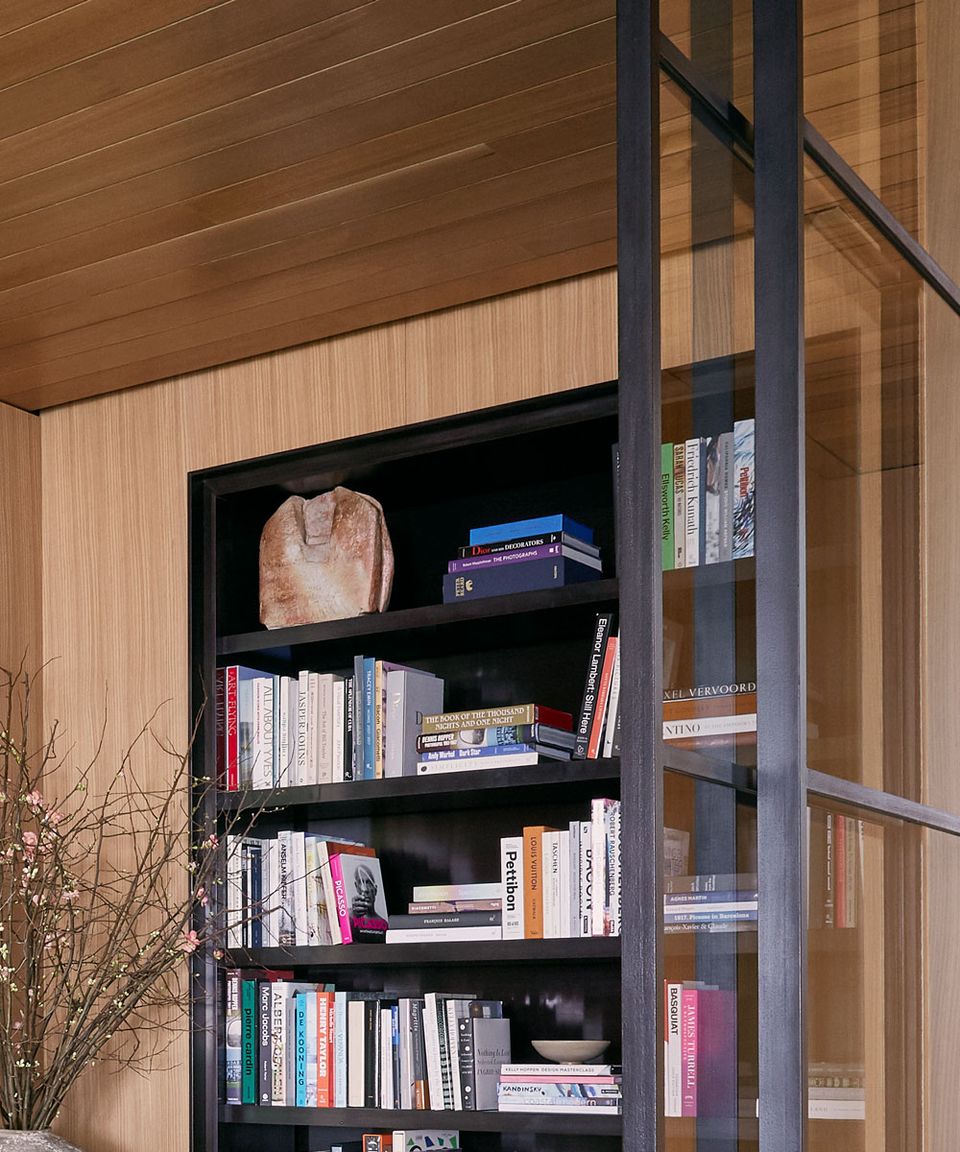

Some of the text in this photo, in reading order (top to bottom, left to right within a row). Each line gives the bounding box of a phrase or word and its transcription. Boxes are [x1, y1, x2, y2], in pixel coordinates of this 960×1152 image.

[674, 446, 684, 494] SARAH LUCAS
[687, 443, 698, 535] Friedrich Kunath
[662, 473, 670, 541] Ellsworth Kelly
[502, 551, 537, 561] PHOTOGRAPHS
[504, 539, 544, 550] DECORATORS
[228, 675, 236, 736] ART FLYING
[580, 618, 607, 734] Eleanor Lambert: Still Here
[264, 685, 273, 777] ALL ABOUT YVES
[298, 690, 306, 767] JASPER JOHNS
[425, 716, 439, 724] THE
[439, 714, 459, 722] BOOK
[472, 711, 485, 719] THE
[487, 707, 525, 718] THOUSAND
[435, 716, 514, 730] NIGHTS AND ONE NIGHT
[428, 752, 439, 760] Andy
[334, 880, 346, 917] PICASSO
[505, 851, 518, 911] Pettibon
[244, 1008, 253, 1076] pierre cardin
[262, 986, 270, 1046] Marc Jacobs
[299, 1011, 304, 1026] DE
[319, 997, 327, 1077] HENRY TAYLOR
[411, 1003, 419, 1032] Magritte
[670, 988, 679, 1036] BASQUIAT
[687, 1004, 695, 1089] JAMES TURRELL
